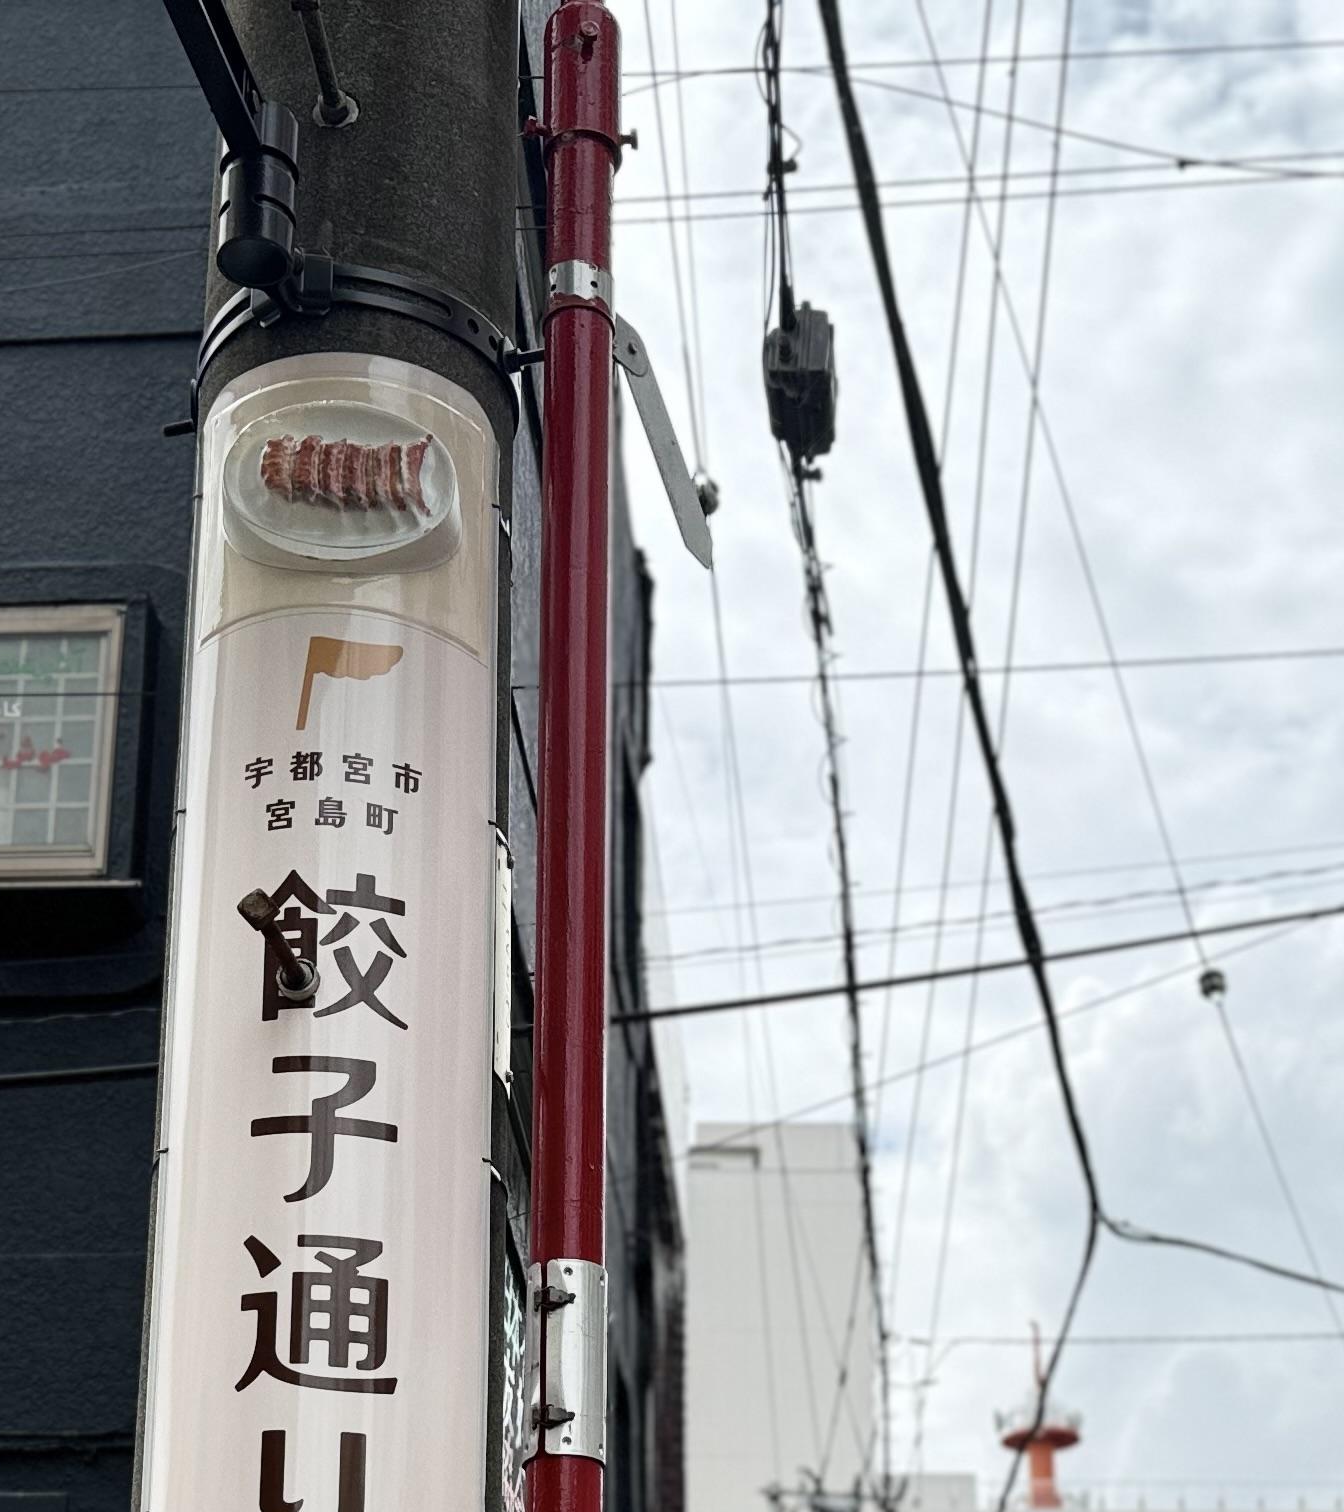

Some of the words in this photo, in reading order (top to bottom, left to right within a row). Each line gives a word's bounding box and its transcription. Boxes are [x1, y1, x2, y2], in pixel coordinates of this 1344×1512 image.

[244, 751, 423, 794] 宇都宮市
[265, 796, 399, 836] 宮島町
